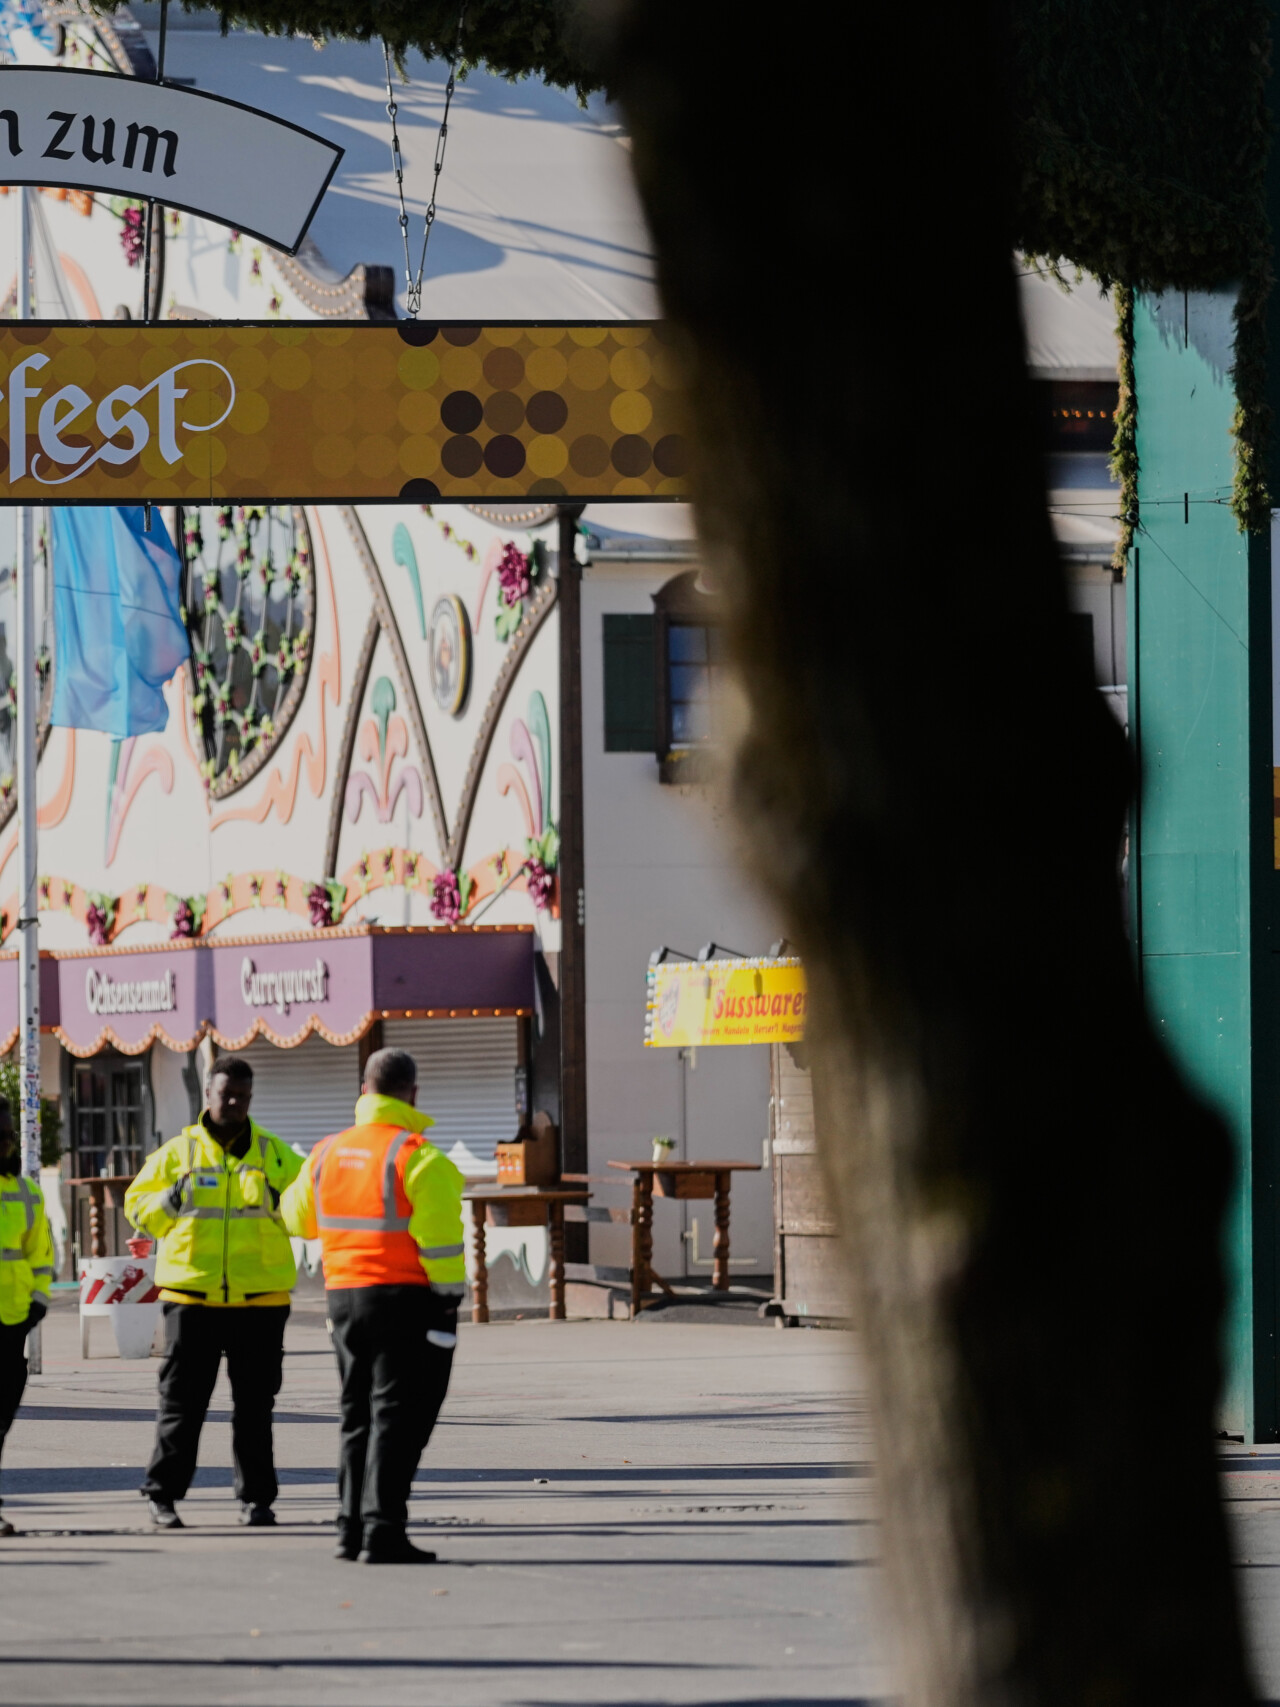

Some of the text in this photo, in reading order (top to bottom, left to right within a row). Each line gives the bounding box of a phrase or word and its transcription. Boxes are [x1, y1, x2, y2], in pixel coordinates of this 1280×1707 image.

[41, 110, 179, 178] zum
[86, 967, 174, 1014] Ochsensemmel
[240, 956, 327, 1015] Currywurst
[713, 988, 807, 1020] Süssware
